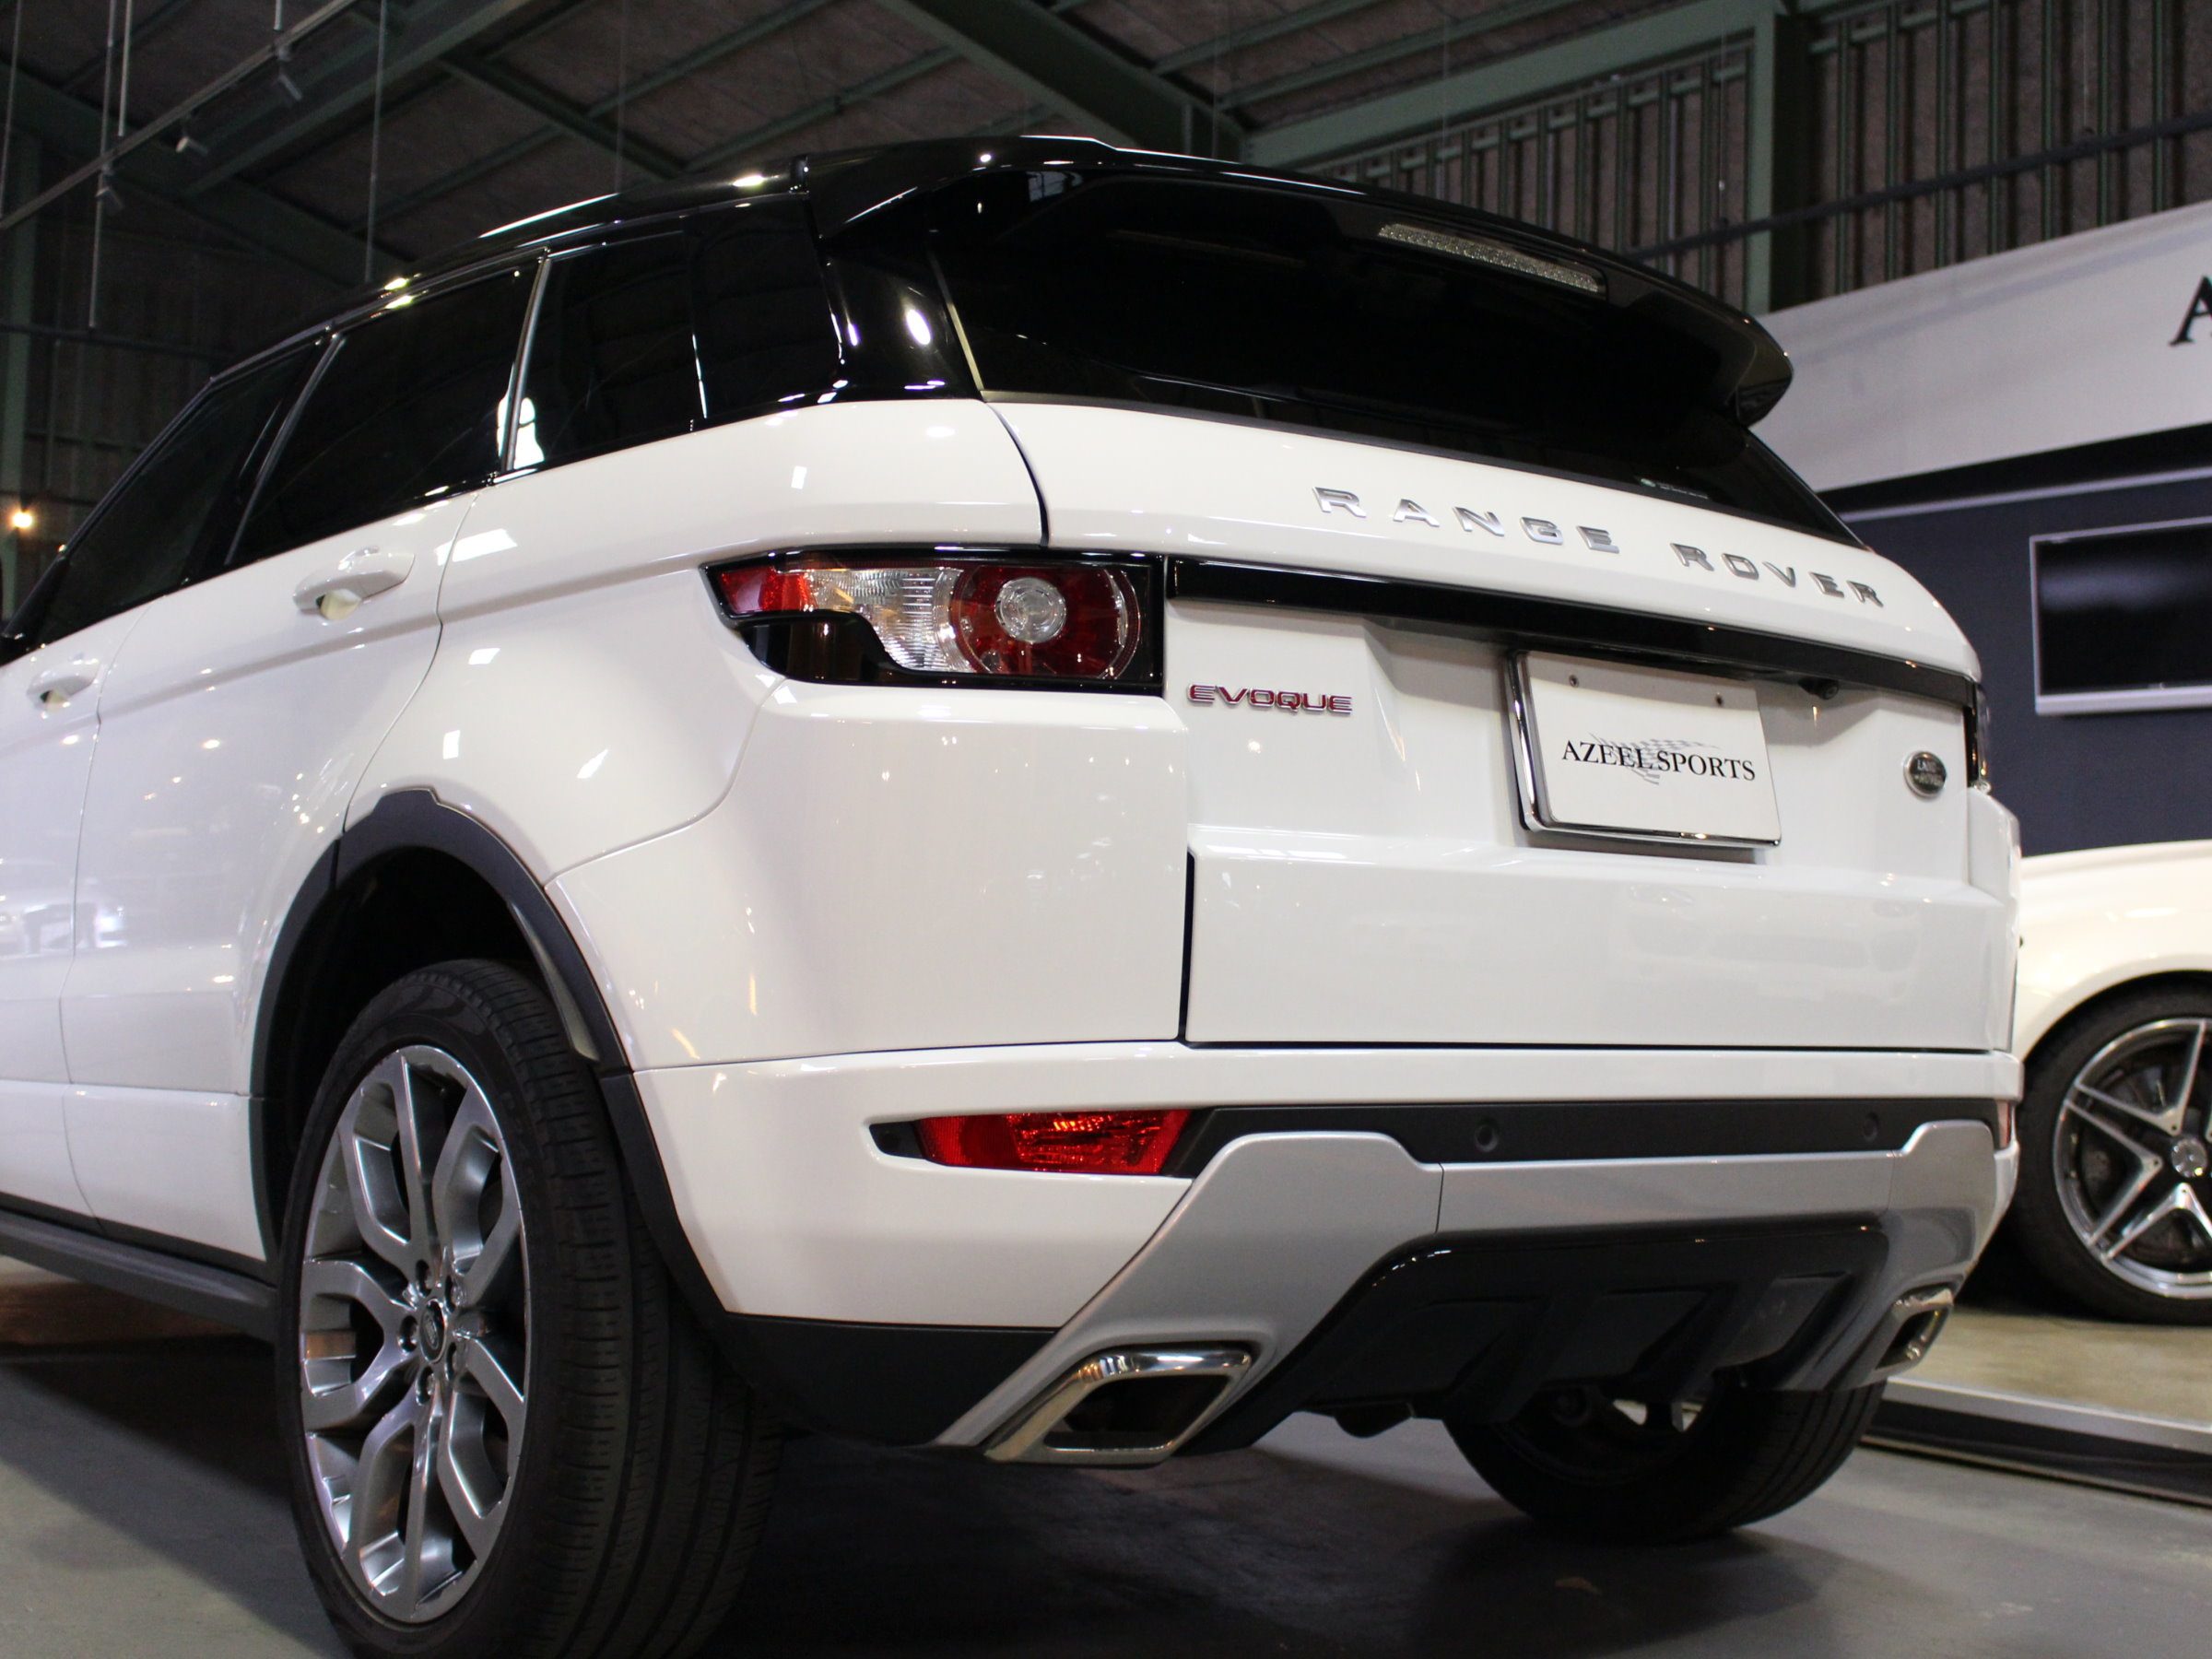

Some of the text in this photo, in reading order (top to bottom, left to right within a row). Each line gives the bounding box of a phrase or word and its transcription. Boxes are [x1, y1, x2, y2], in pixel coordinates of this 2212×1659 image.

[1312, 486, 1884, 608] RANGE ROVER
[1187, 683, 1353, 715] EVOQUE
